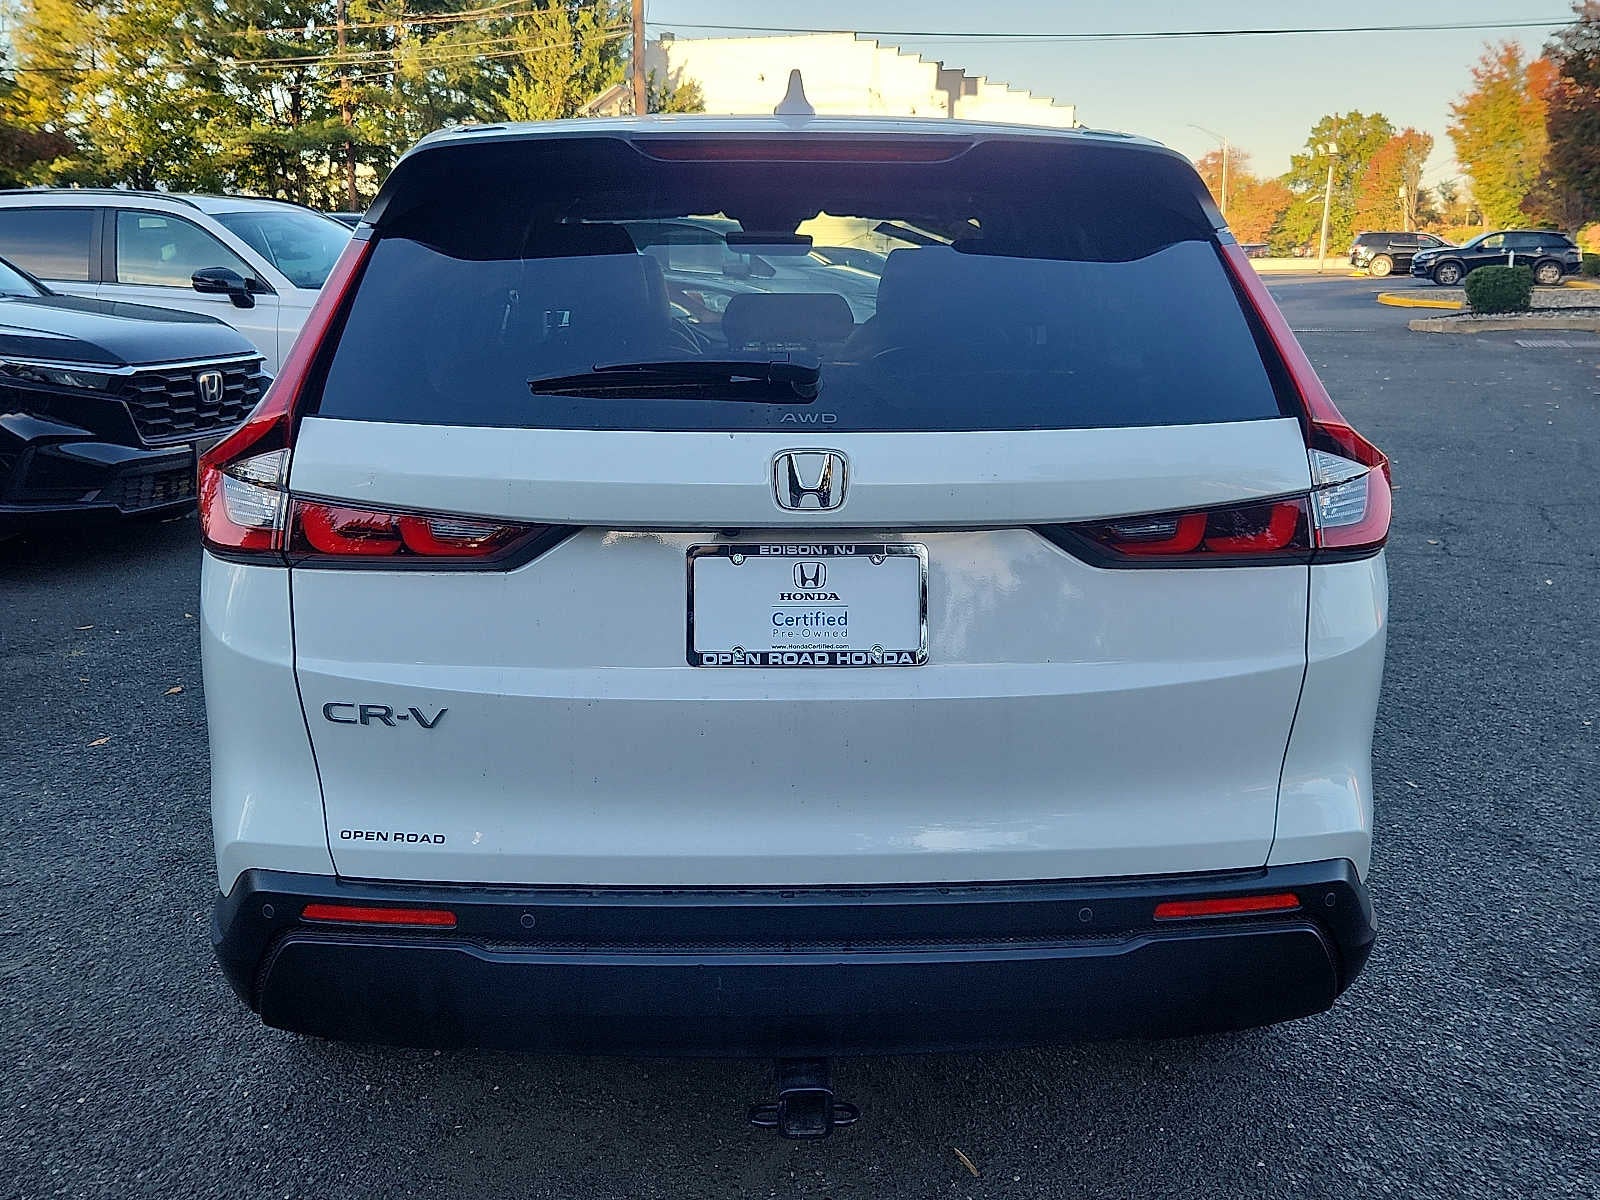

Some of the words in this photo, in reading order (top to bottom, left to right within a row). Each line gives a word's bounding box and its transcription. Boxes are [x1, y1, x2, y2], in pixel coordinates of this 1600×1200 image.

[780, 413, 837, 423] AWD
[759, 545, 828, 555] EDISON,
[833, 545, 856, 555] NJ
[779, 592, 841, 601] HONDA
[771, 611, 848, 627] Certified
[772, 628, 848, 638] Pre-Owned
[702, 653, 760, 665] OPEN
[768, 653, 829, 665] ROAD
[836, 652, 914, 664] HONDA
[322, 702, 449, 729] CR-V
[340, 829, 389, 842] OPEN
[393, 832, 446, 844] ROAD
